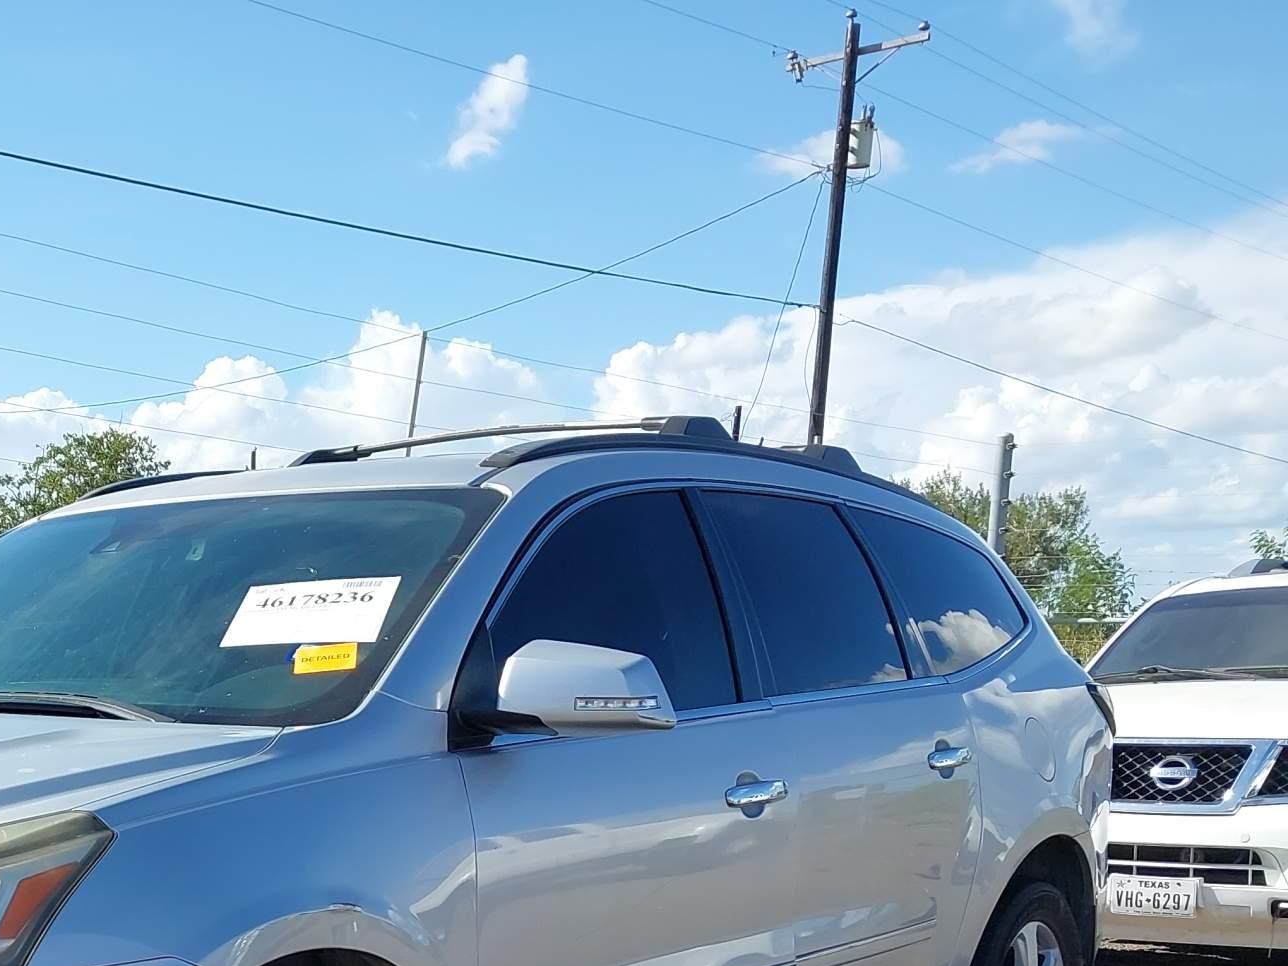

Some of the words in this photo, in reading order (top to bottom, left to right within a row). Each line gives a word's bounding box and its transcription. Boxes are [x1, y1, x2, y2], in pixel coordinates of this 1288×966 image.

[255, 590, 374, 609] 46178236
[300, 652, 351, 664] DETAILED
[1138, 880, 1170, 889] TEXAS
